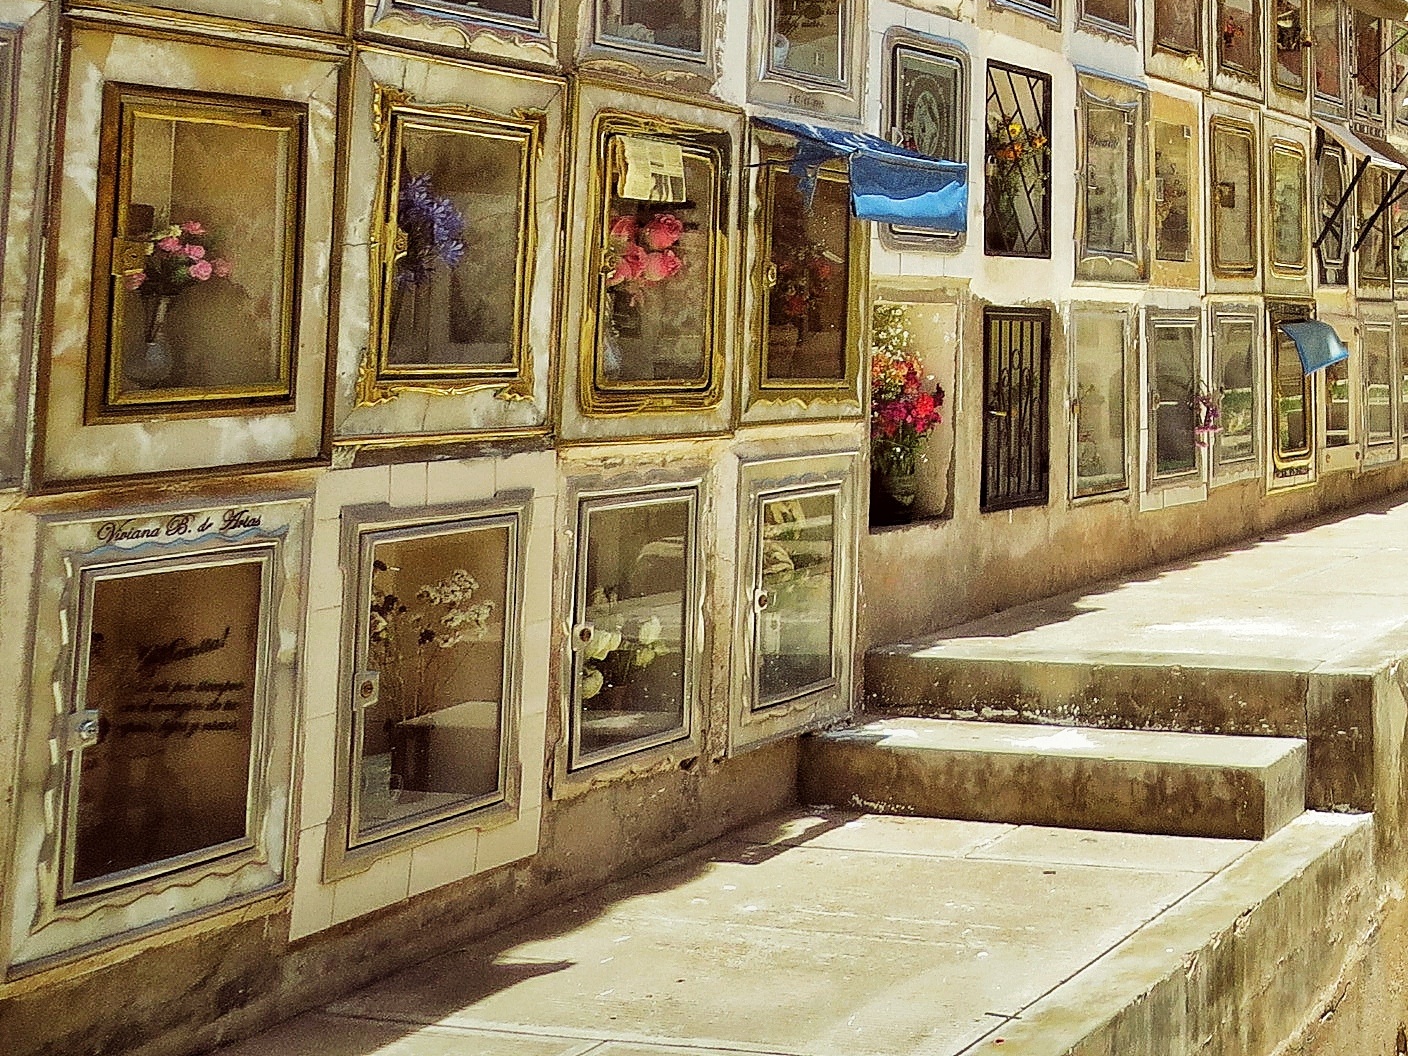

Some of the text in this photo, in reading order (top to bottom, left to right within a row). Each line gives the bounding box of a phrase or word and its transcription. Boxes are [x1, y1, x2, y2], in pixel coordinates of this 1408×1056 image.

[97, 518, 162, 544] Viviana
[165, 513, 196, 537] B.
[218, 509, 263, 531] Arias
